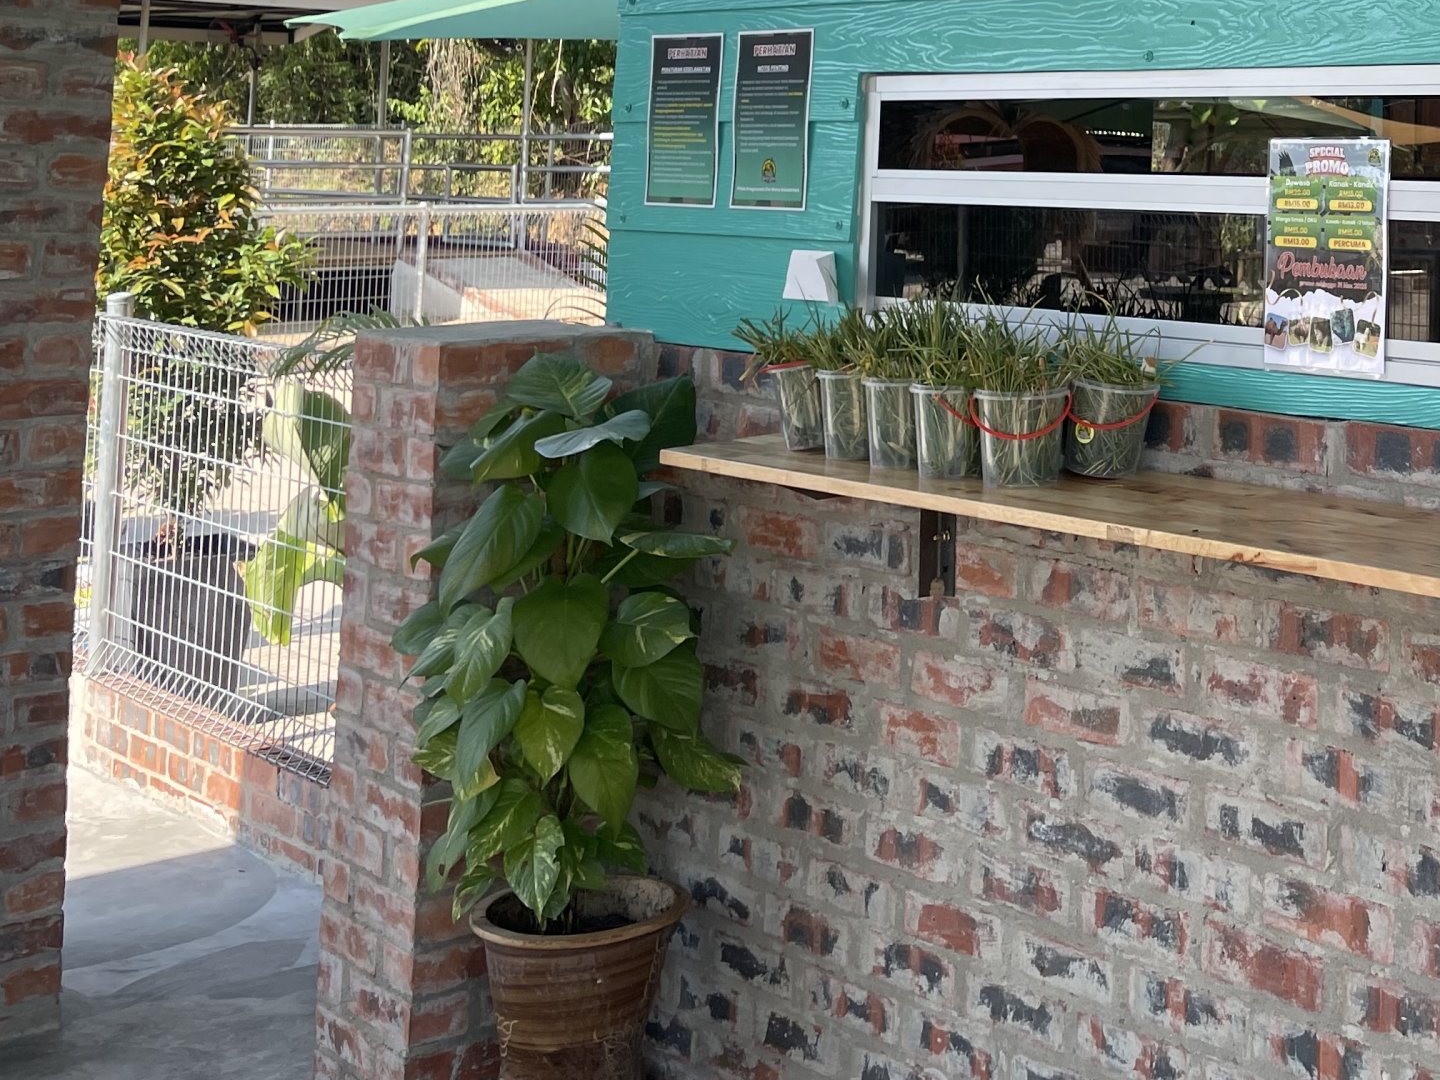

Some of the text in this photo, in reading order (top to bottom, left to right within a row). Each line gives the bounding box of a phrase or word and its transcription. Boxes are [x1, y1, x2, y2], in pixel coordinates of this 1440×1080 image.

[753, 43, 797, 57] PERHATIAN
[1309, 147, 1345, 158] SPECIAL
[1305, 160, 1349, 175] PROMO
[1334, 240, 1366, 248] PERCUMA
[1277, 251, 1367, 280] Pembukaan
